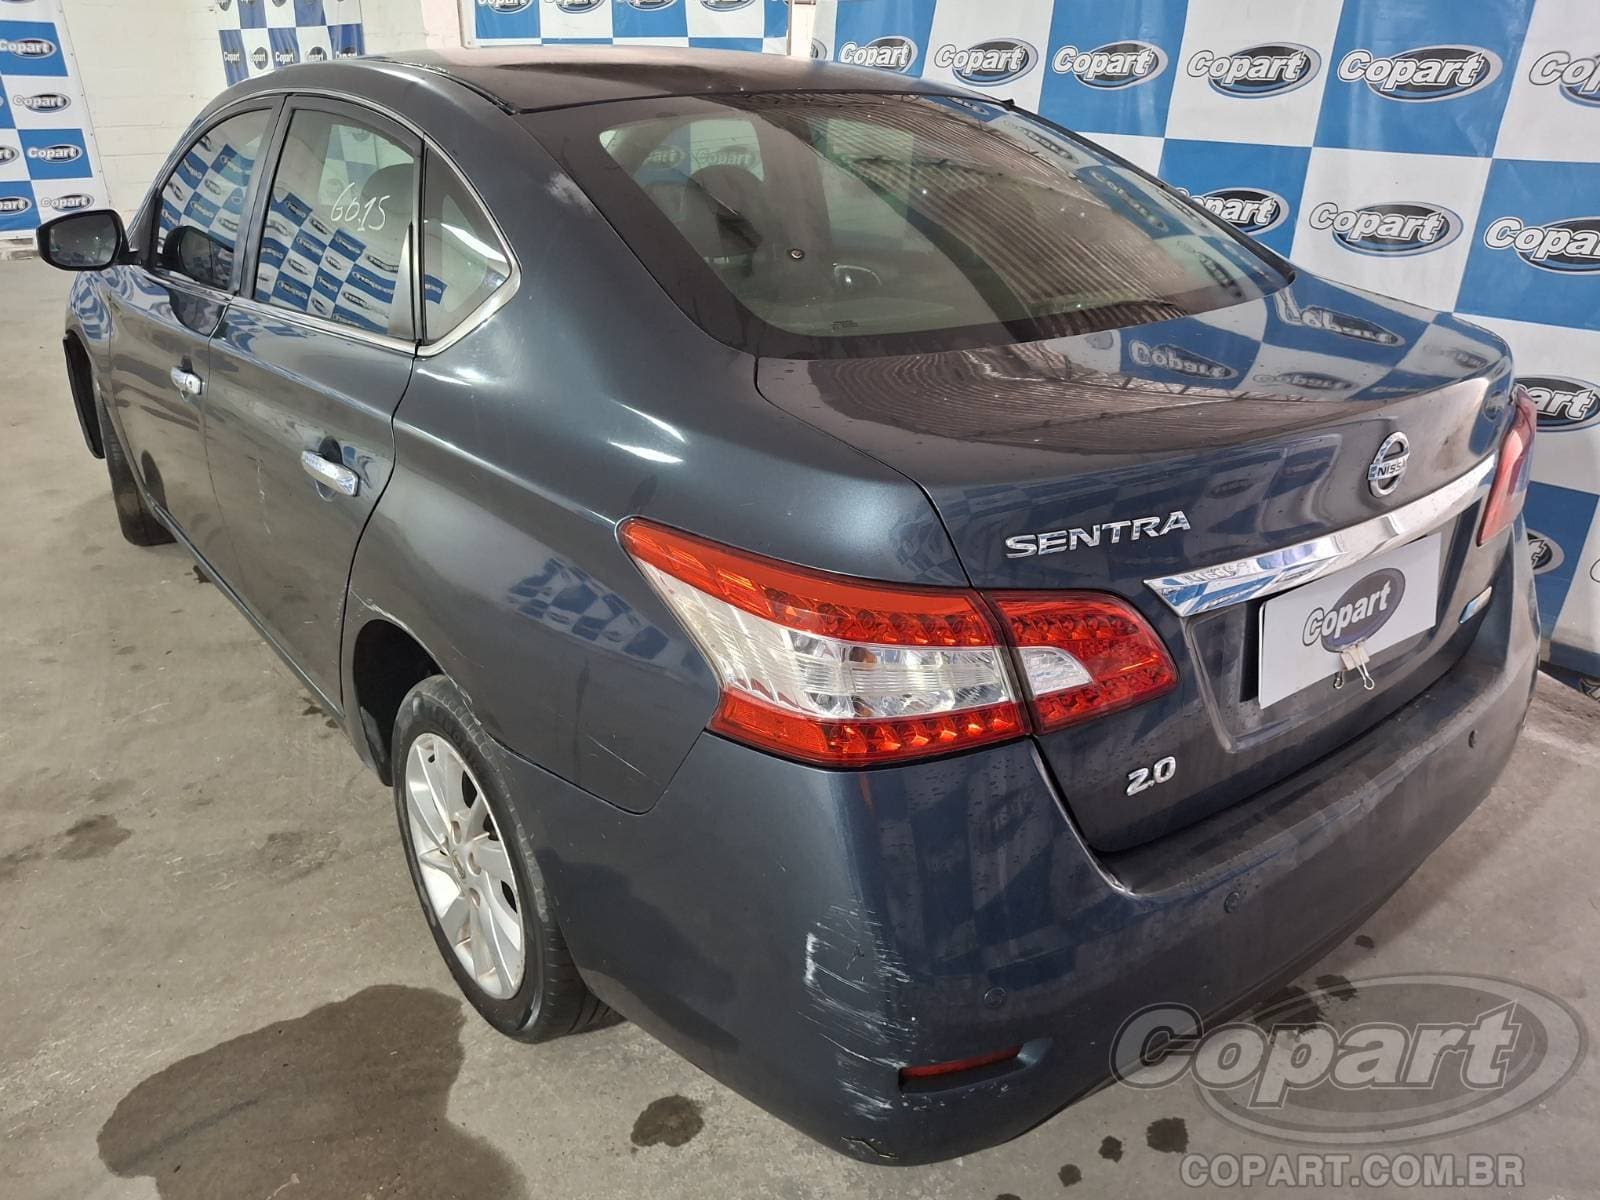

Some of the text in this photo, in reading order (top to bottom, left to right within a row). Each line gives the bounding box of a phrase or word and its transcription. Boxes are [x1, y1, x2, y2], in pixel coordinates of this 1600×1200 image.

[837, 41, 910, 66] Copart
[935, 43, 1027, 75] Copart
[1051, 45, 1153, 81] Copart
[1187, 49, 1306, 86] Copart
[1336, 48, 1485, 91] Copart
[13, 94, 66, 110] Copart
[27, 146, 77, 162] Copart
[41, 196, 89, 213] Copart
[1309, 201, 1445, 242] Copart
[1483, 216, 1600, 261] Copa
[1004, 510, 1192, 559] SENTRA
[1302, 580, 1392, 647] Copart
[1126, 756, 1176, 797] 2.0
